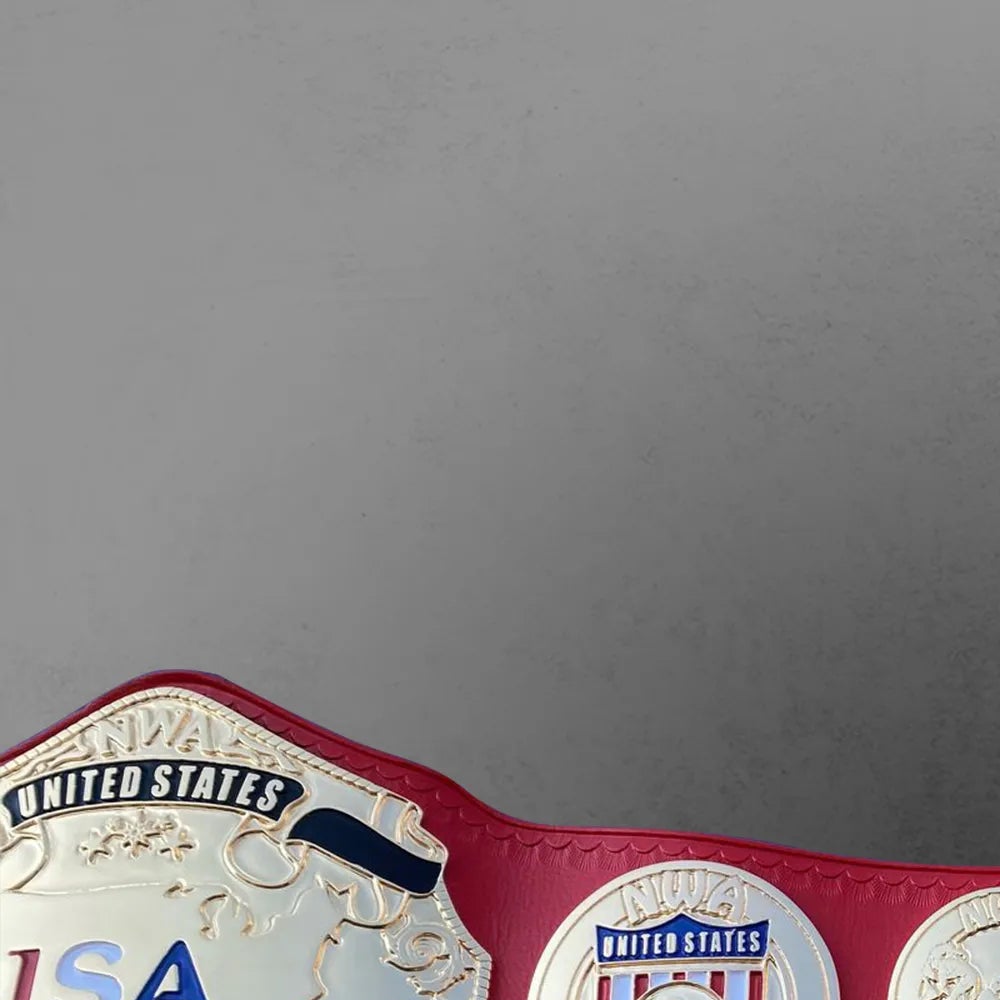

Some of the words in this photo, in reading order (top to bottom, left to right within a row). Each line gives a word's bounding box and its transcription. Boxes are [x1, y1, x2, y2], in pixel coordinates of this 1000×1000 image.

[98, 707, 216, 757] NWA
[18, 766, 142, 817] UNITED
[151, 764, 285, 812] STATES
[621, 869, 748, 925] NWA
[603, 932, 677, 957] UNITED
[684, 929, 761, 954] STATES
